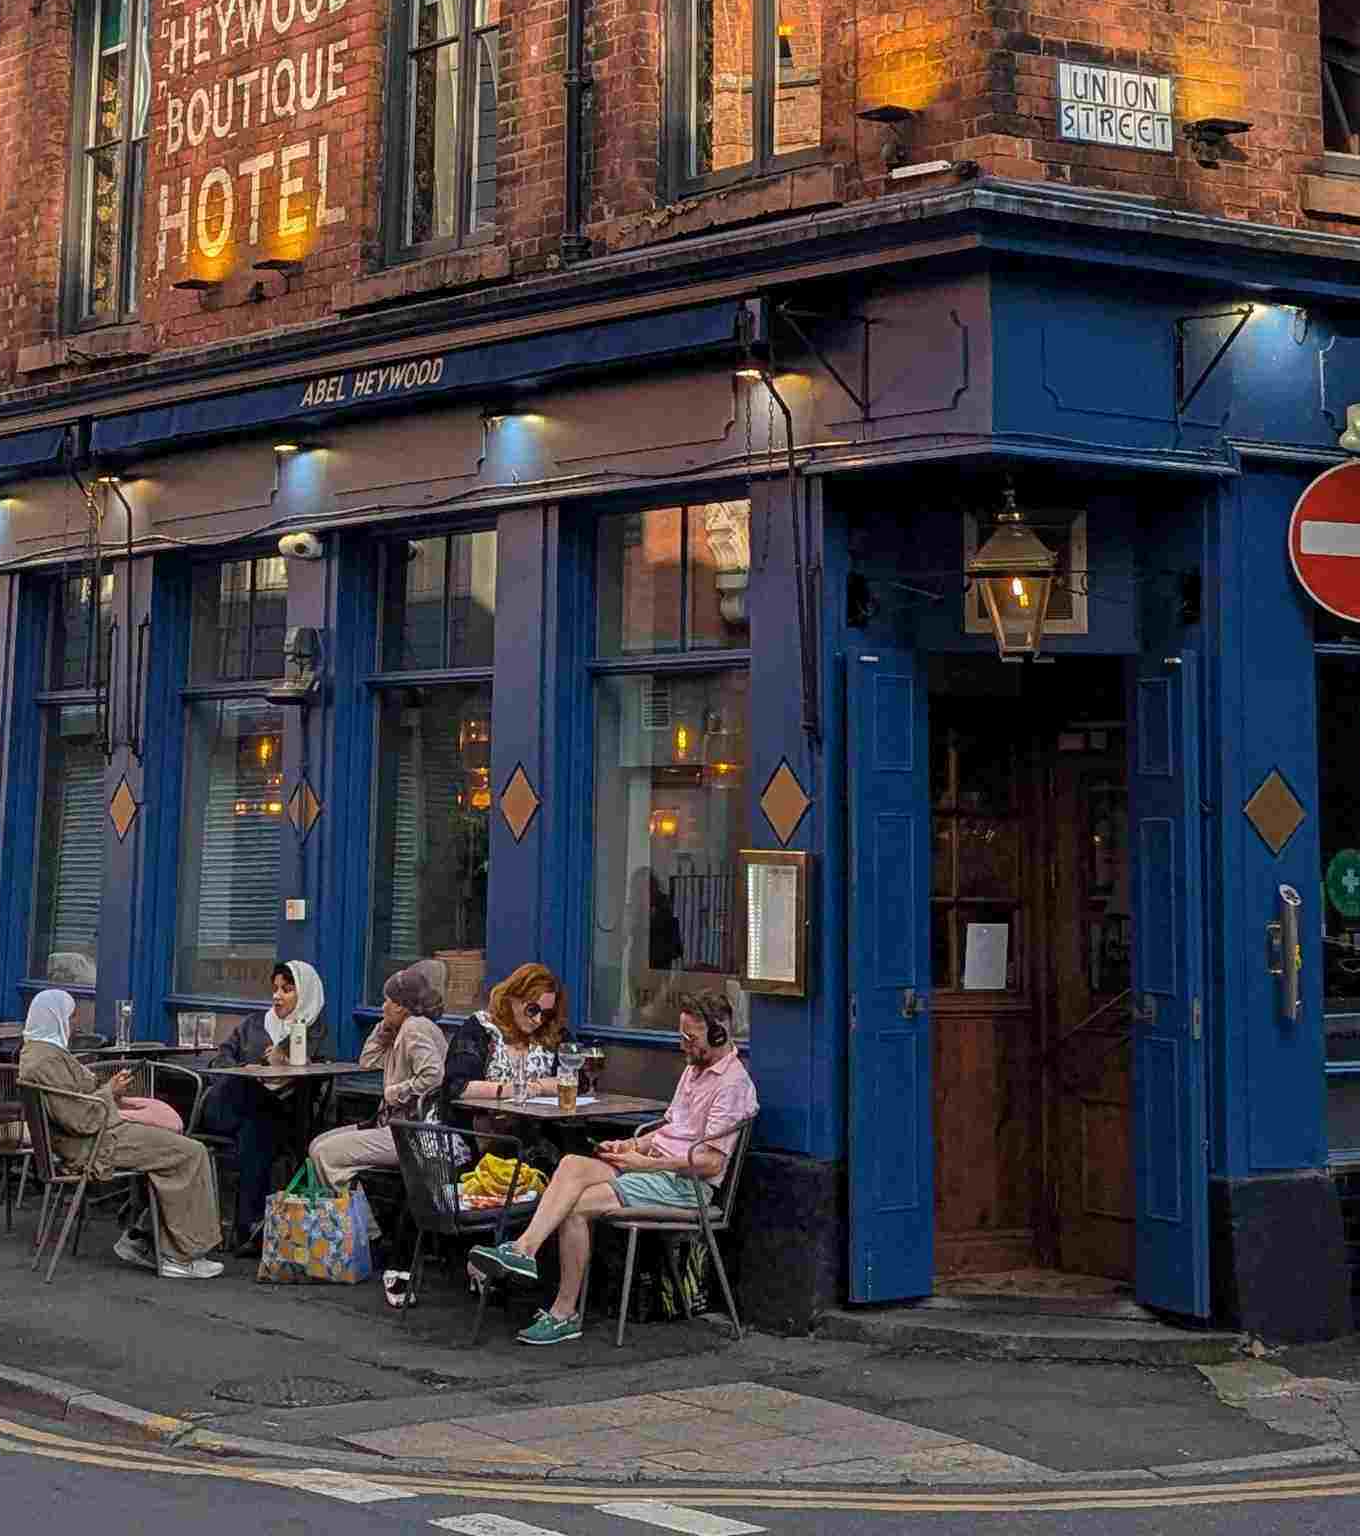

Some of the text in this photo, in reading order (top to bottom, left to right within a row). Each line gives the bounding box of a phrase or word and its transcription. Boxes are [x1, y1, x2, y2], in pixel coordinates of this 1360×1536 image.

[167, 39, 348, 154] BOUTIQUE
[1073, 71, 1157, 110] UNION
[1063, 105, 1169, 145] STREET
[156, 135, 345, 273] HOTEL
[300, 358, 444, 407] ABEL HEYWOOD
